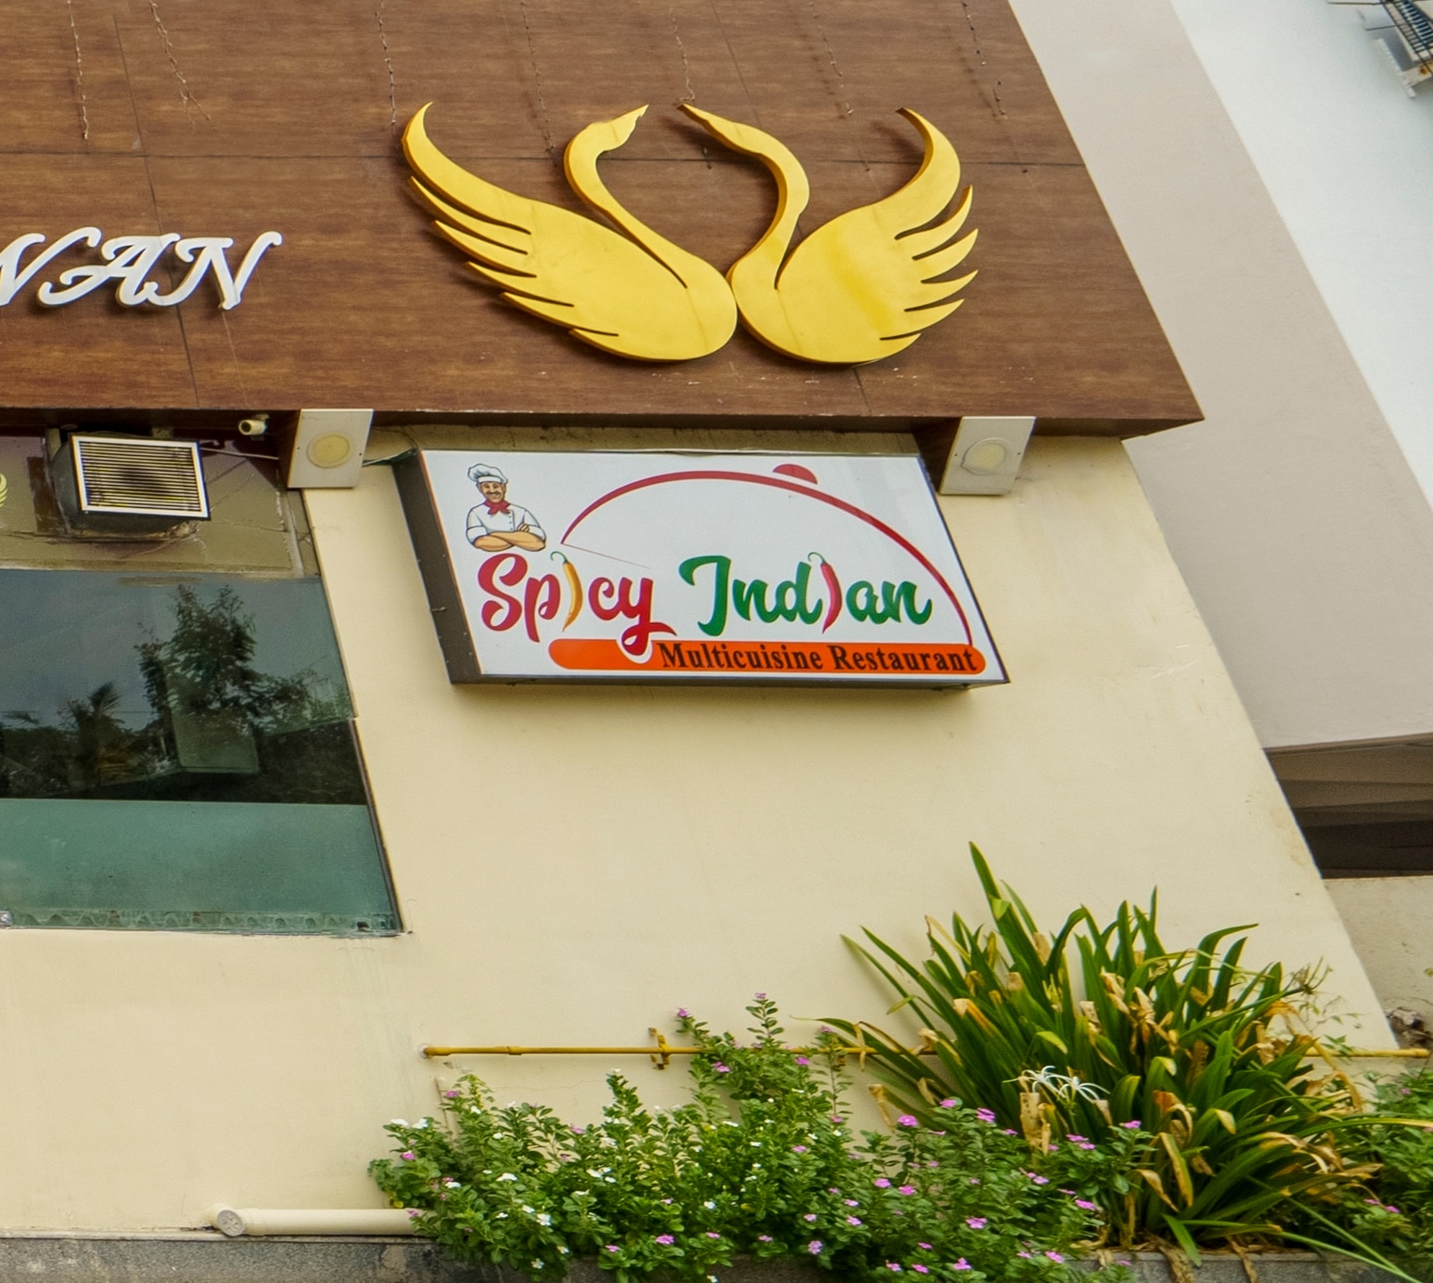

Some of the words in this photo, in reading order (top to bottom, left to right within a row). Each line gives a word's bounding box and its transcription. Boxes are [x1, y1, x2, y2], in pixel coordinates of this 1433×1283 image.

[477, 550, 678, 657] Spicy
[678, 551, 933, 637] Indian
[658, 640, 825, 672] Multicuisine
[833, 644, 978, 673] Restaurant
